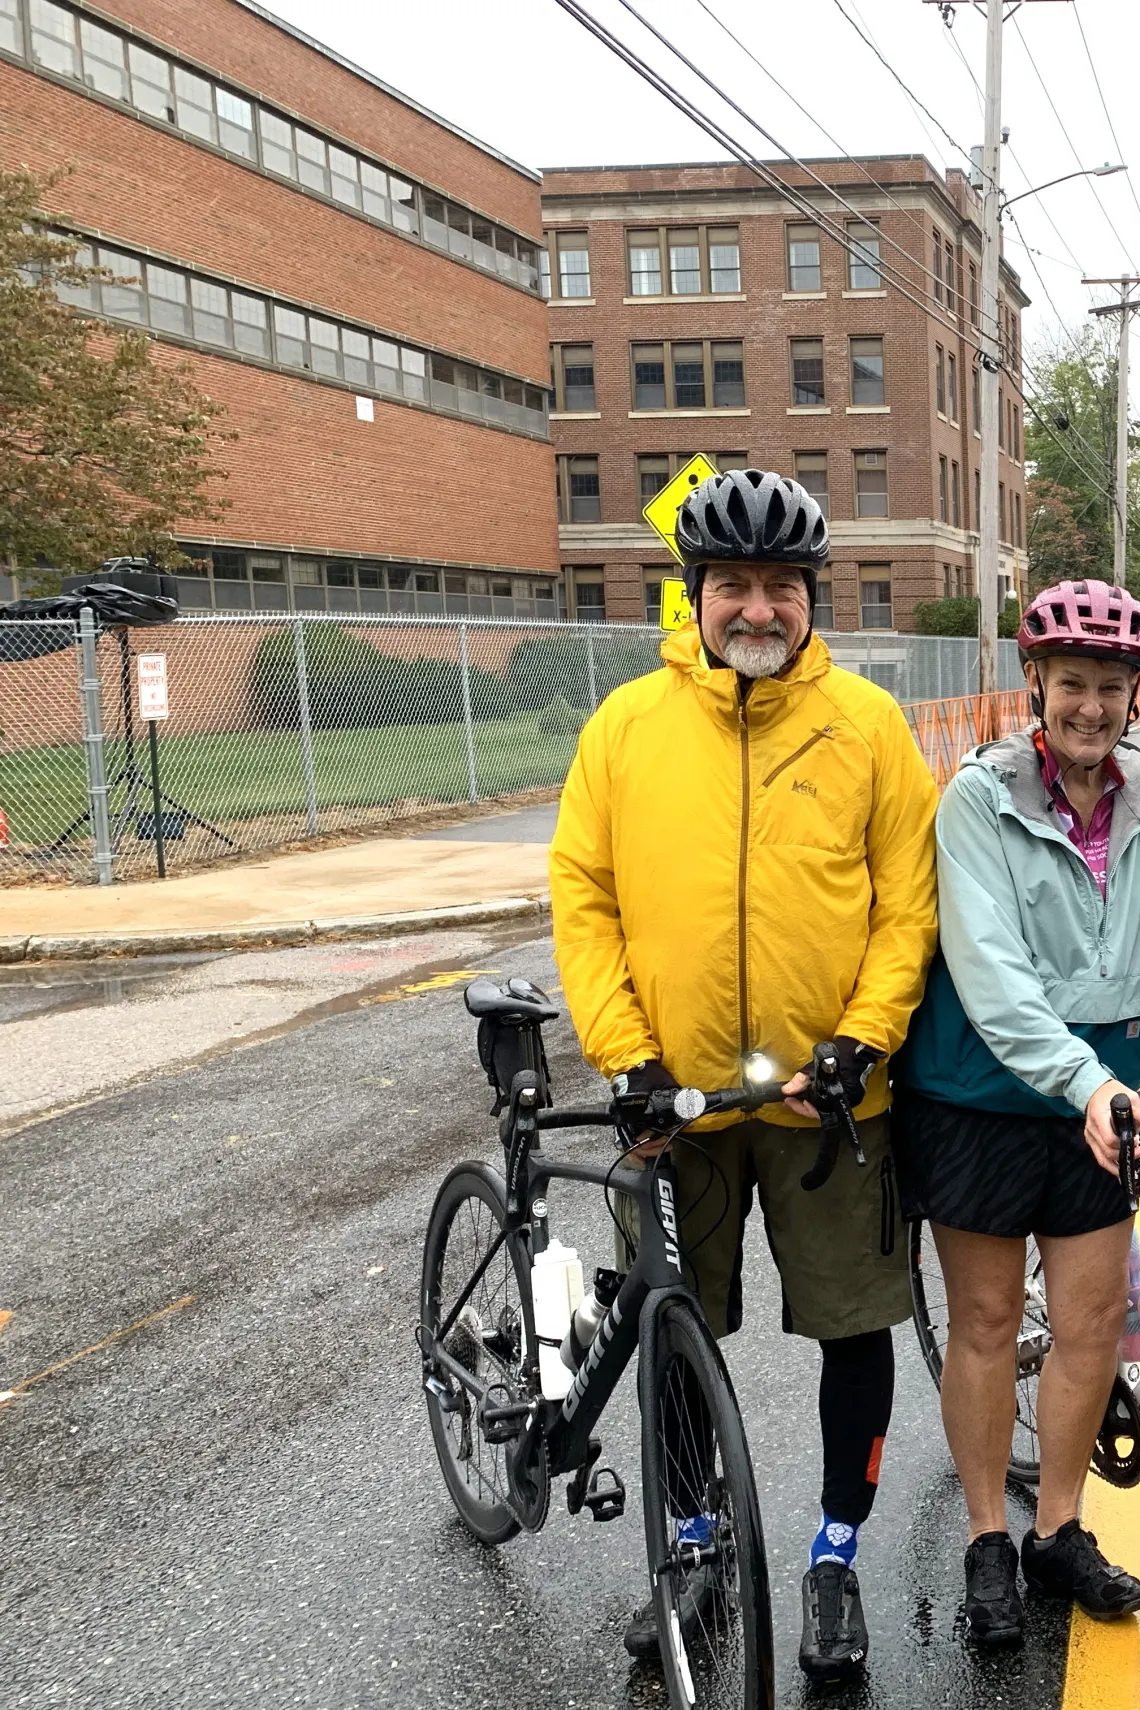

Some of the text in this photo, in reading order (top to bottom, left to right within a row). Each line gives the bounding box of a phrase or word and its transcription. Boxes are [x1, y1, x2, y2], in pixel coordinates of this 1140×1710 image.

[140, 676, 164, 686] PROPERTY
[143, 661, 161, 671] PRIVATE
[839, 1099, 859, 1144] ULTEGRA
[511, 1136, 526, 1191] ULTEGRA
[1126, 1145, 1134, 1195] ULTEGRA
[658, 1177, 682, 1275] GIANT
